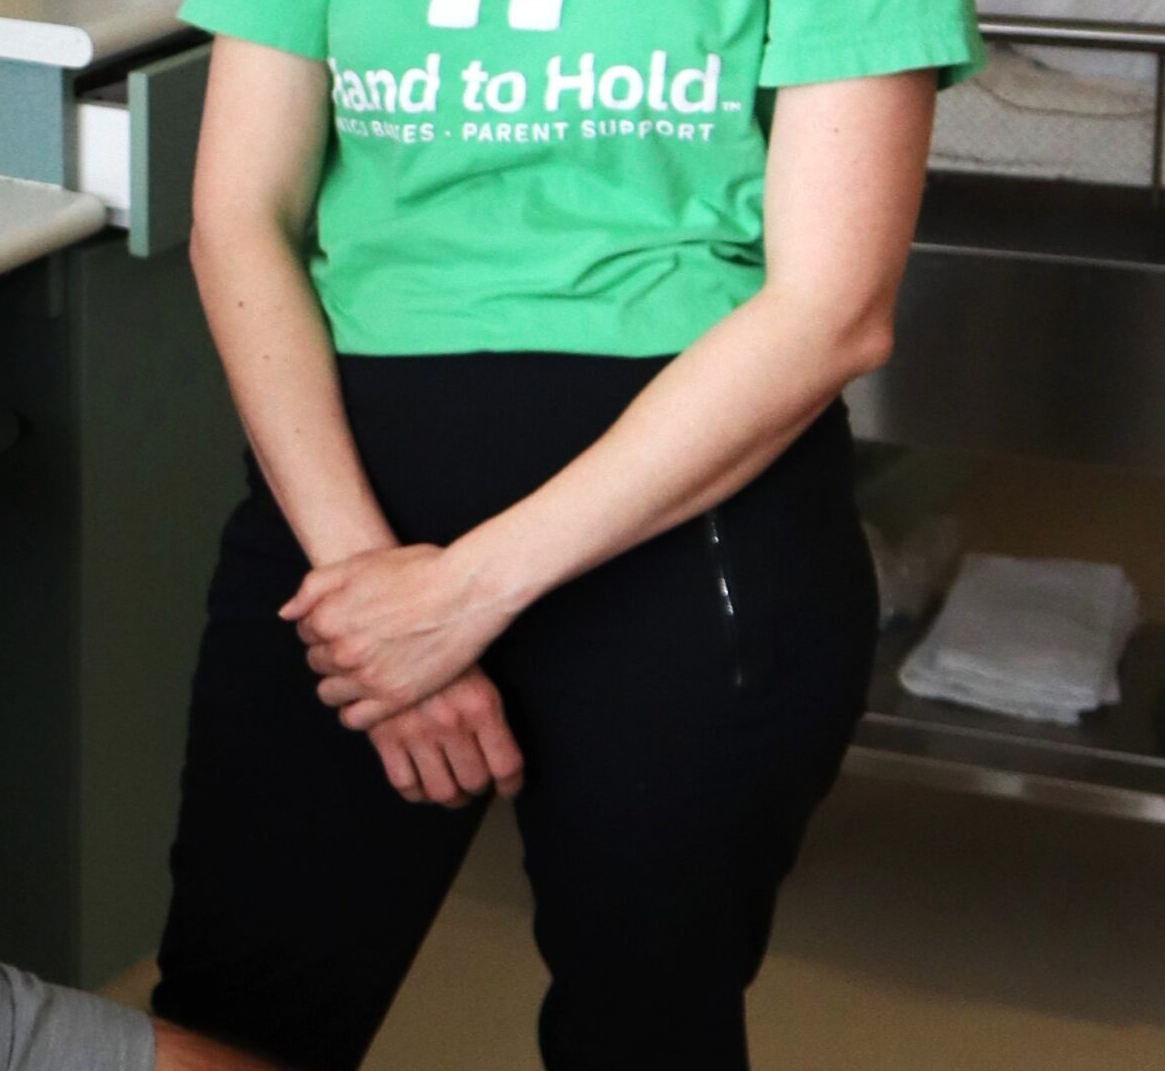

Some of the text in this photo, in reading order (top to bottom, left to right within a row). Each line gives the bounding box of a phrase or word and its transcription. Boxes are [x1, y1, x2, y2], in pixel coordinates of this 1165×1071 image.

[461, 60, 527, 113] to
[544, 49, 722, 113] Hold
[462, 121, 569, 143] PARENT
[581, 119, 715, 142] SUPPORT
